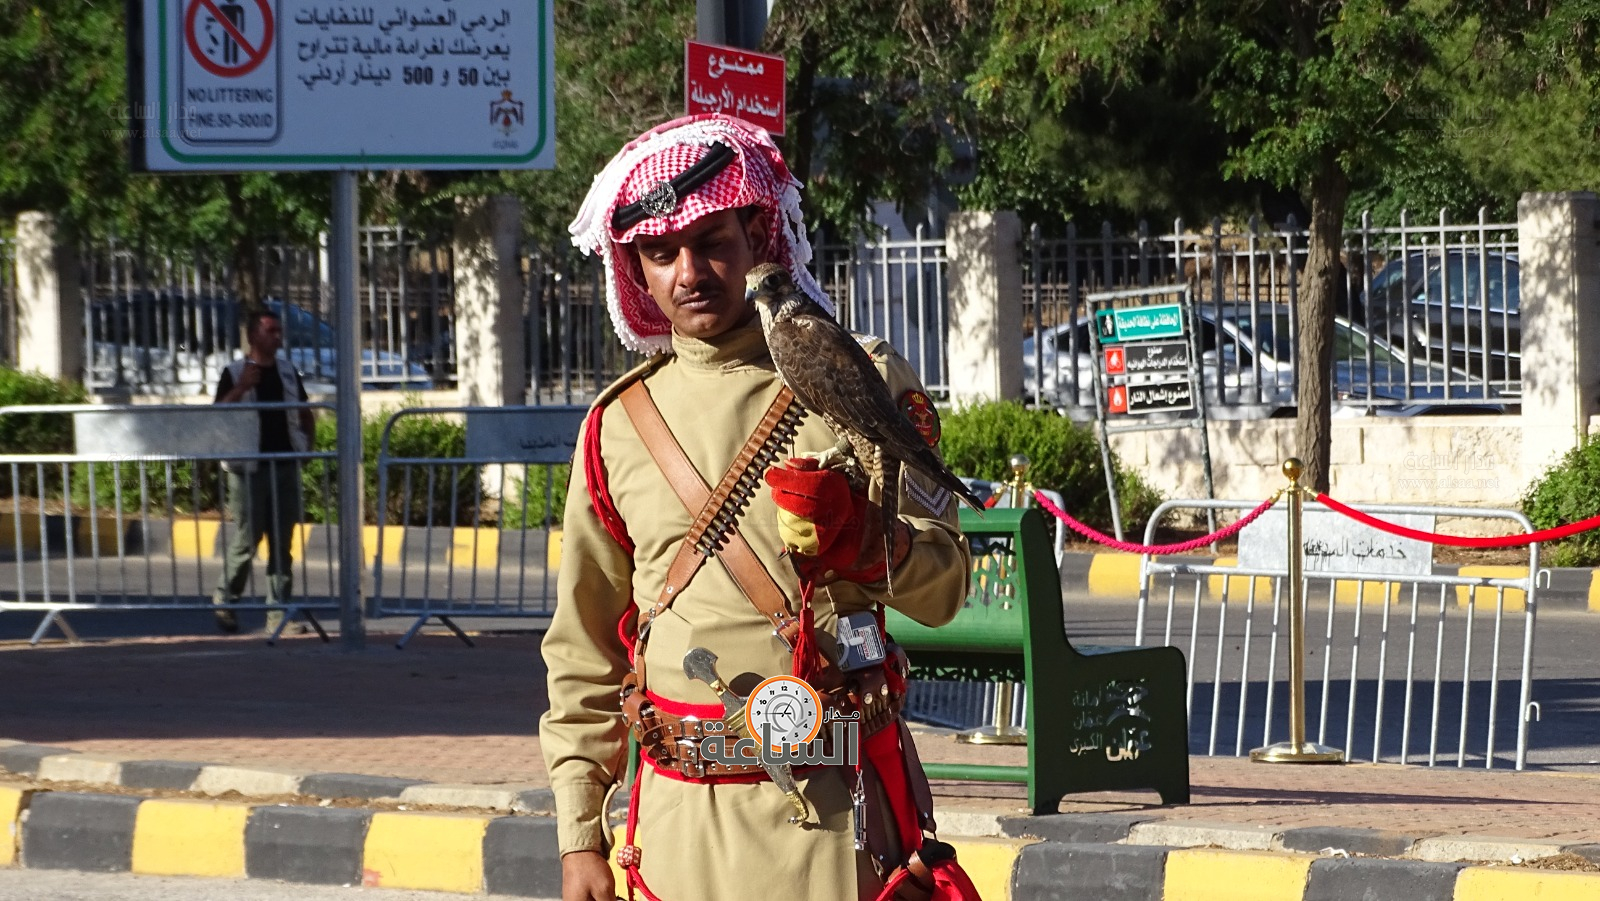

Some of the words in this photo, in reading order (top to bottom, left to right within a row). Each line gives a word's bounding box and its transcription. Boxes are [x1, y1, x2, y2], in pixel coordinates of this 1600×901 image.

[294, 6, 374, 31] للنفايات
[379, 6, 456, 36] العشوائي
[460, 8, 511, 37] الرمي
[297, 37, 349, 62] تتراوح
[353, 38, 393, 60] مالية
[396, 38, 444, 60] لغرامة
[448, 38, 511, 61] يعرضك
[350, 63, 392, 87] دينار
[402, 66, 434, 87] 500
[458, 66, 479, 87] 50
[483, 66, 511, 88] بين
[707, 53, 765, 79] ممنوع
[440, 68, 450, 88] و
[690, 80, 734, 114] الأرجيلة
[1129, 389, 1147, 406] النار
[1167, 385, 1190, 405] ممنوع
